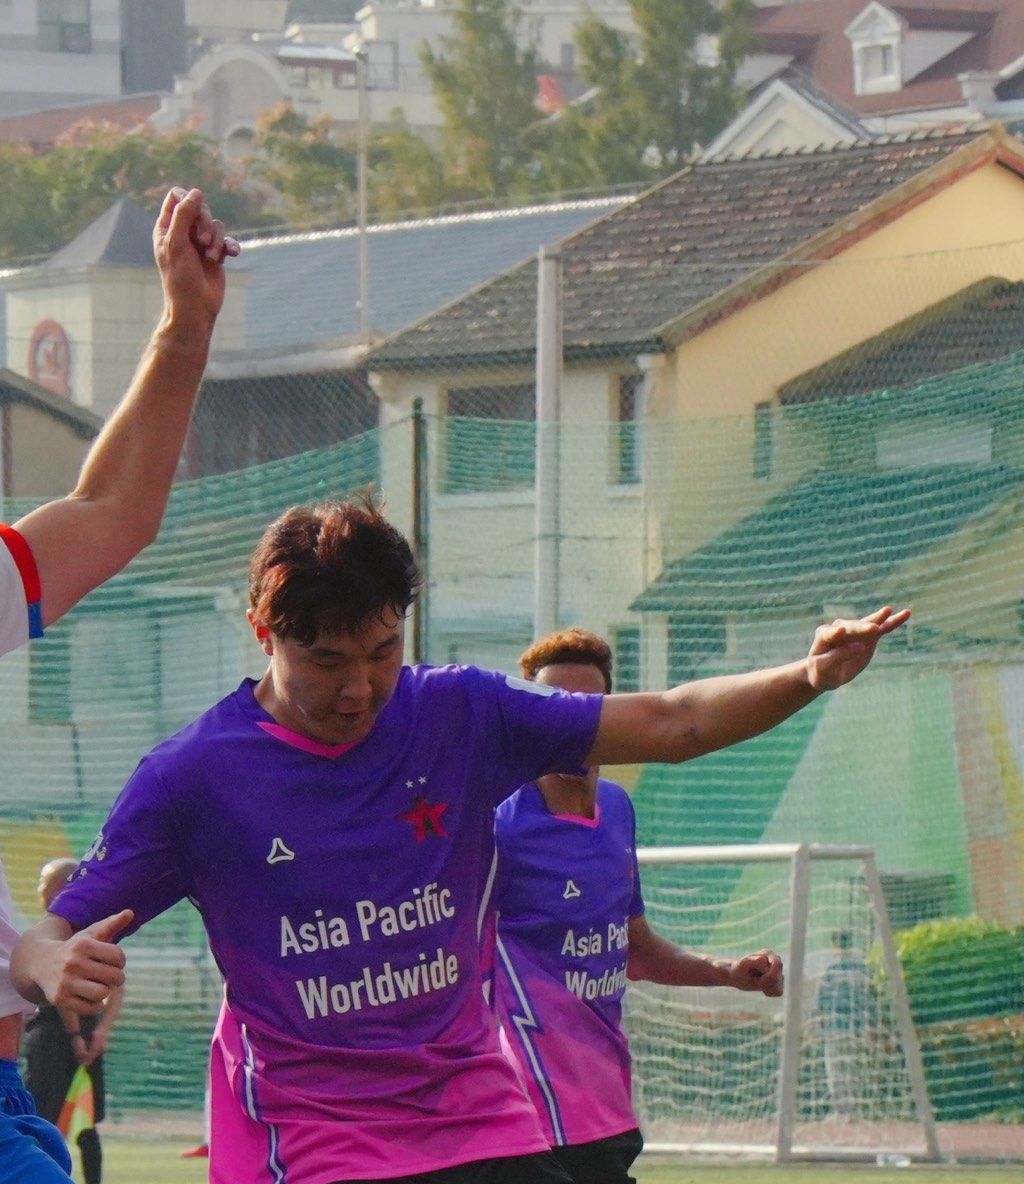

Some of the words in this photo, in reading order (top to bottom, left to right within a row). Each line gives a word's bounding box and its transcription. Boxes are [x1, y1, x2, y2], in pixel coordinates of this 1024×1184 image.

[280, 909, 351, 957] Asia
[355, 882, 456, 942] Pacific
[561, 927, 602, 957] Asia
[295, 947, 459, 1020] Worldwide
